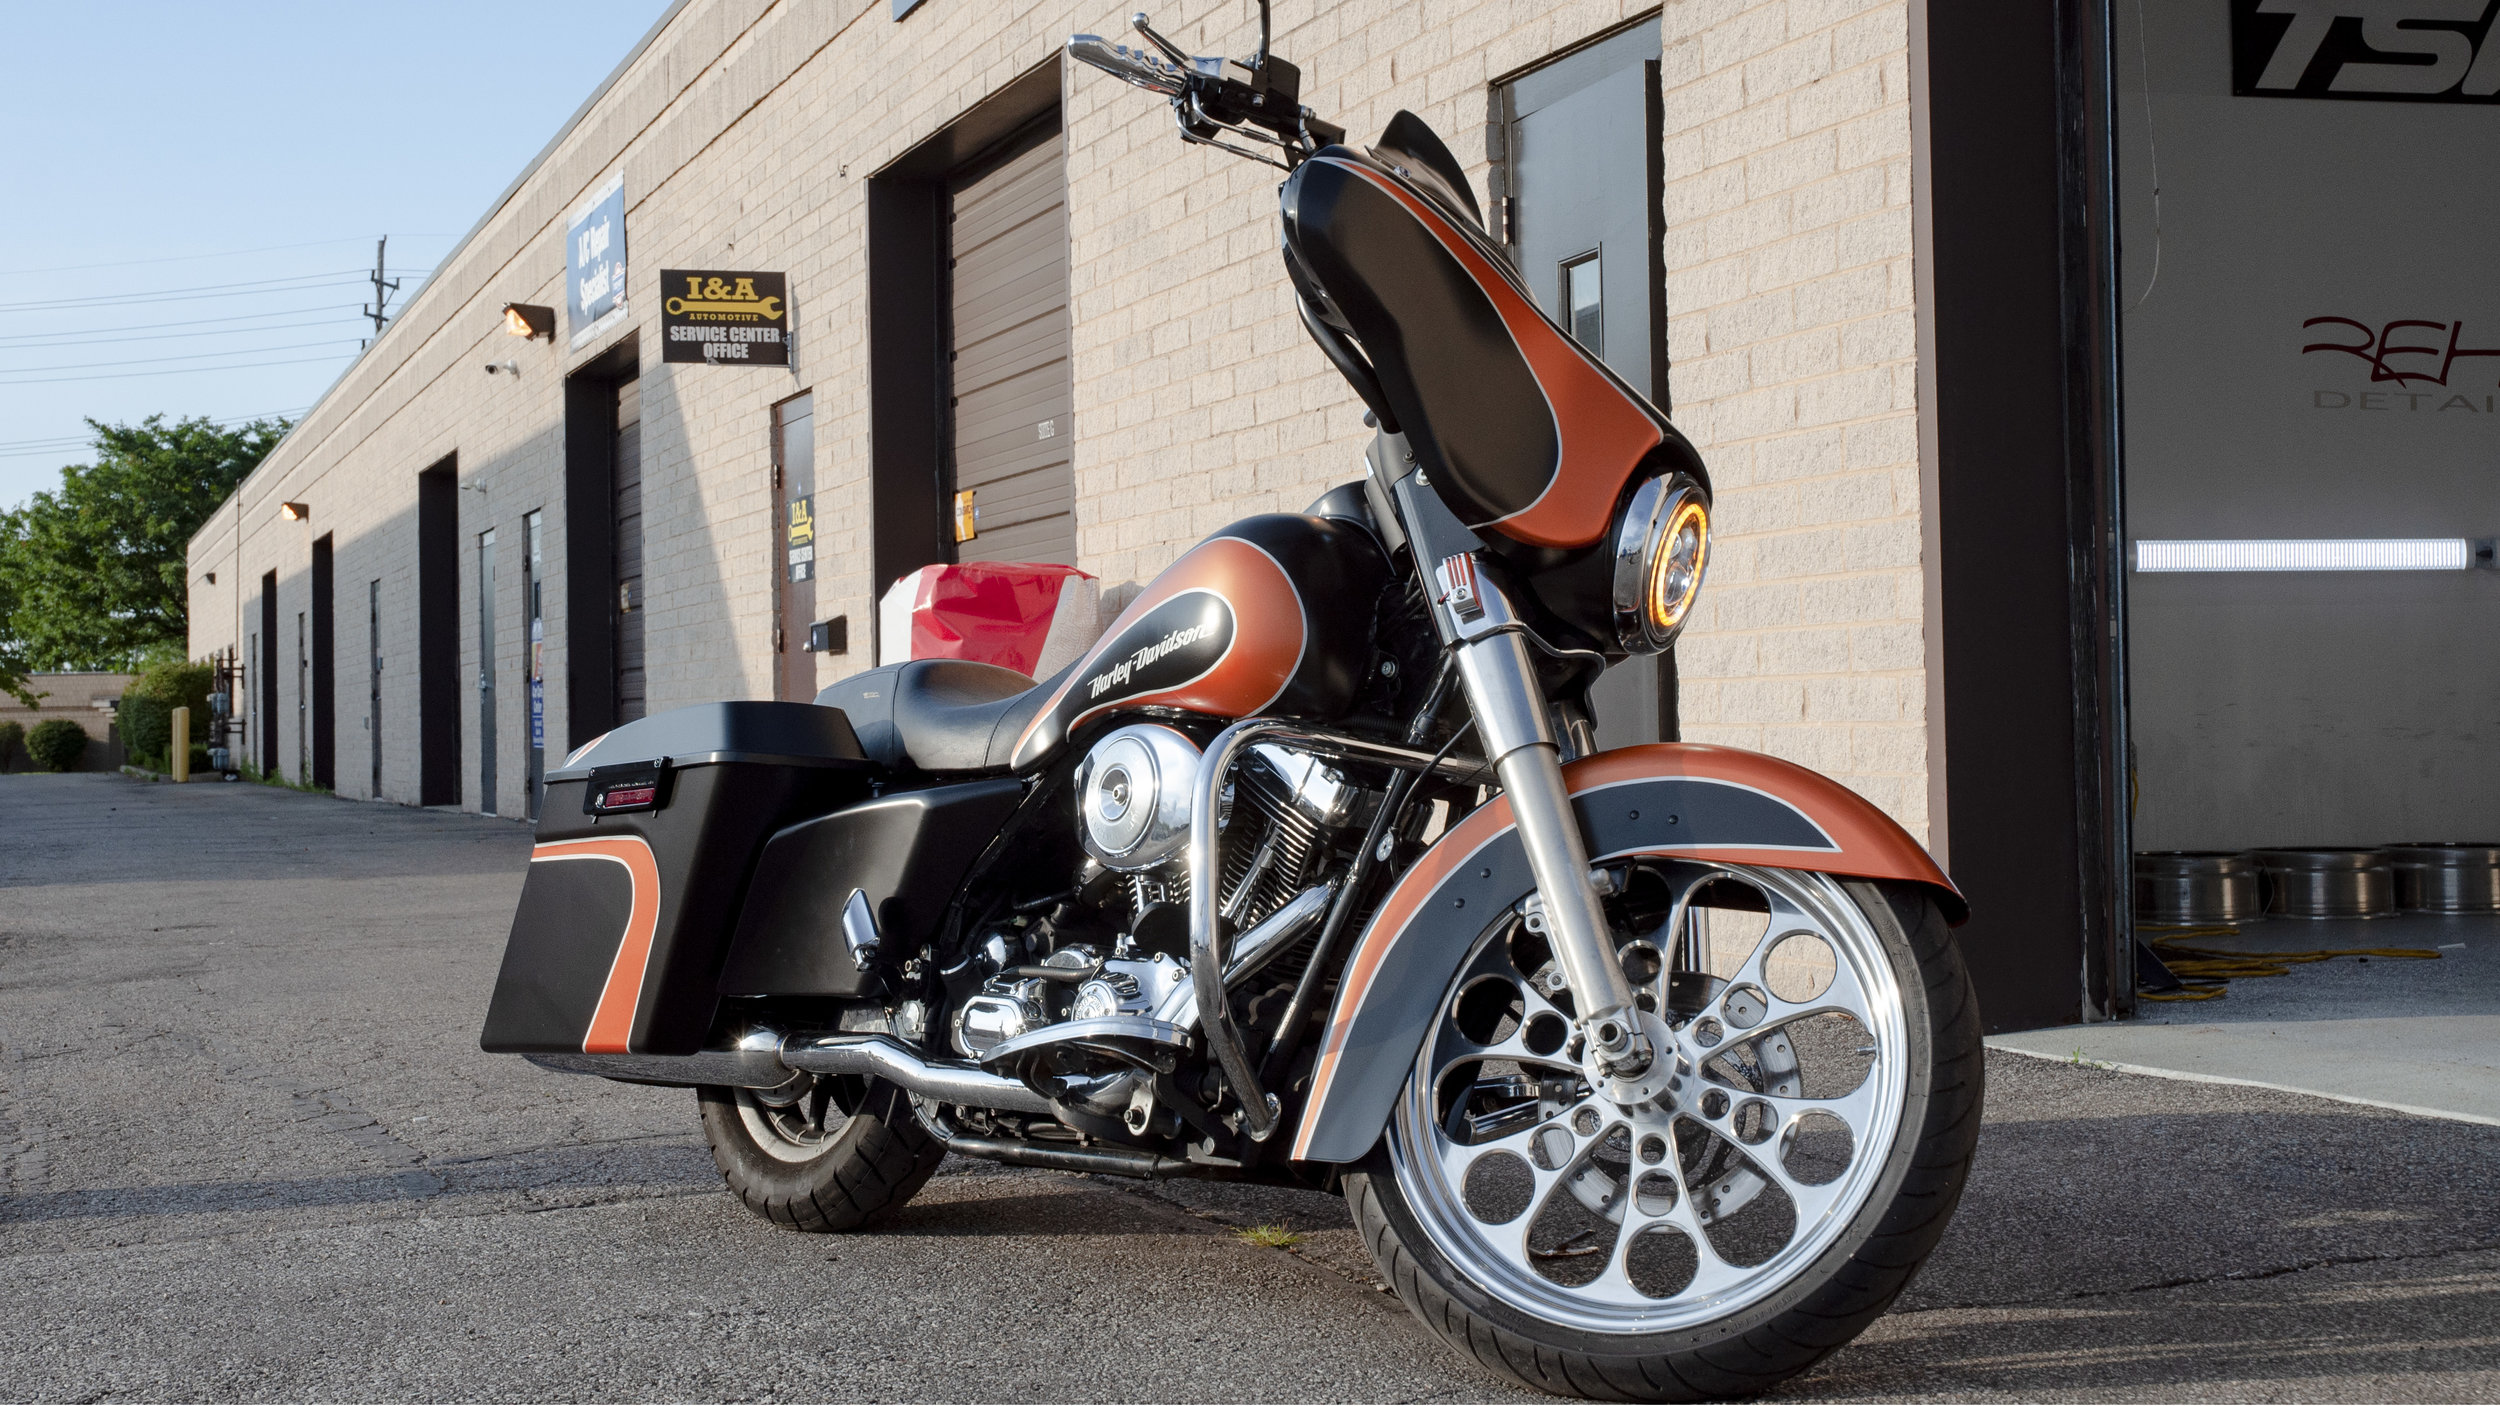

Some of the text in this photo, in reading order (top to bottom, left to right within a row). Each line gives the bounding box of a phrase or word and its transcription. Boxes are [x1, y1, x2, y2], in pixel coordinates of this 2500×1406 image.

[590, 215, 610, 262] Repair
[580, 260, 610, 316] Specialist
[686, 277, 759, 300] I&A
[689, 313, 759, 321] AUTOMOTIVE
[670, 325, 780, 343] SERVICE CENTER
[703, 342, 749, 359] OFFICE
[791, 499, 808, 526] I&A
[1087, 624, 1214, 699] Harley-Davidson
